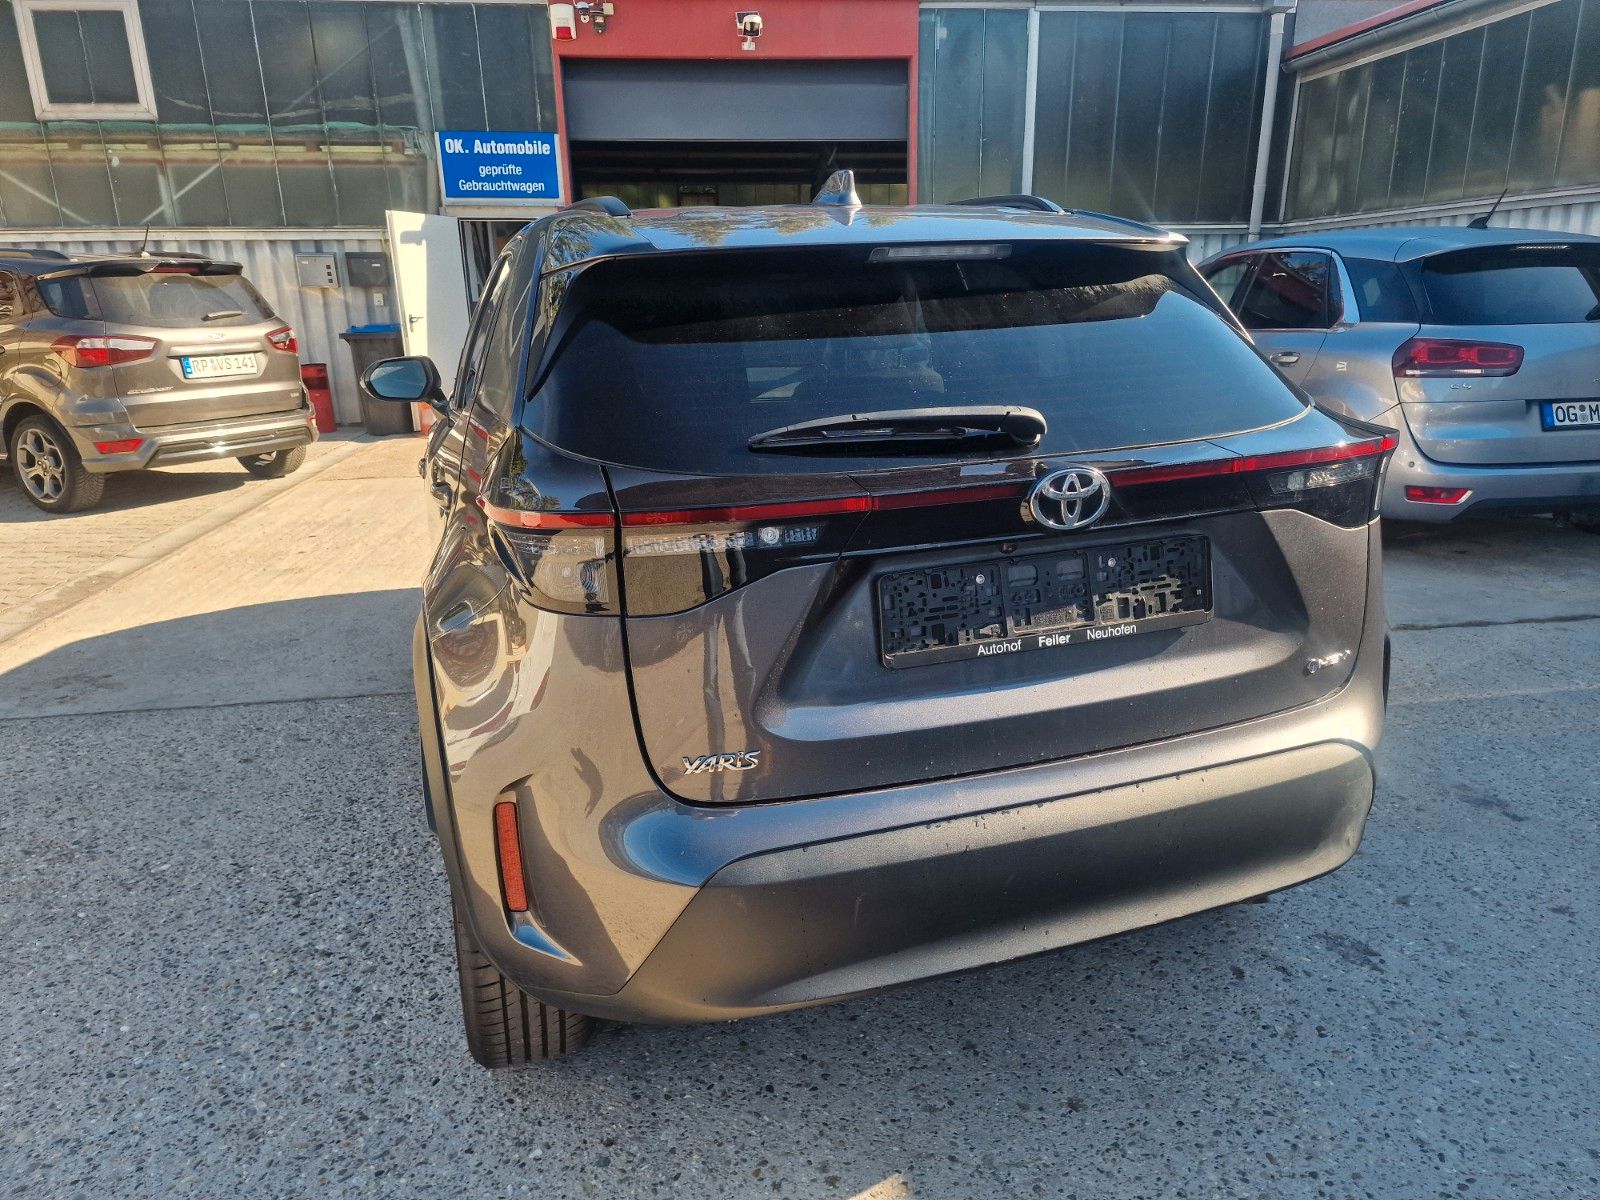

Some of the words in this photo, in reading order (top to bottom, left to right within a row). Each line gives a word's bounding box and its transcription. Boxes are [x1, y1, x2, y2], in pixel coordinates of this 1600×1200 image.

[444, 138, 469, 154] OK.
[474, 139, 551, 155] Automobile
[478, 163, 523, 177] geprüfte
[458, 179, 545, 194] Gebrauchtwagen
[192, 359, 208, 373] RP
[216, 357, 232, 370] VS
[234, 356, 255, 369] 141
[1555, 405, 1579, 423] OG
[977, 639, 1022, 656] Autohof
[1038, 633, 1071, 648] Feiler
[1086, 622, 1137, 641] Neuhofen
